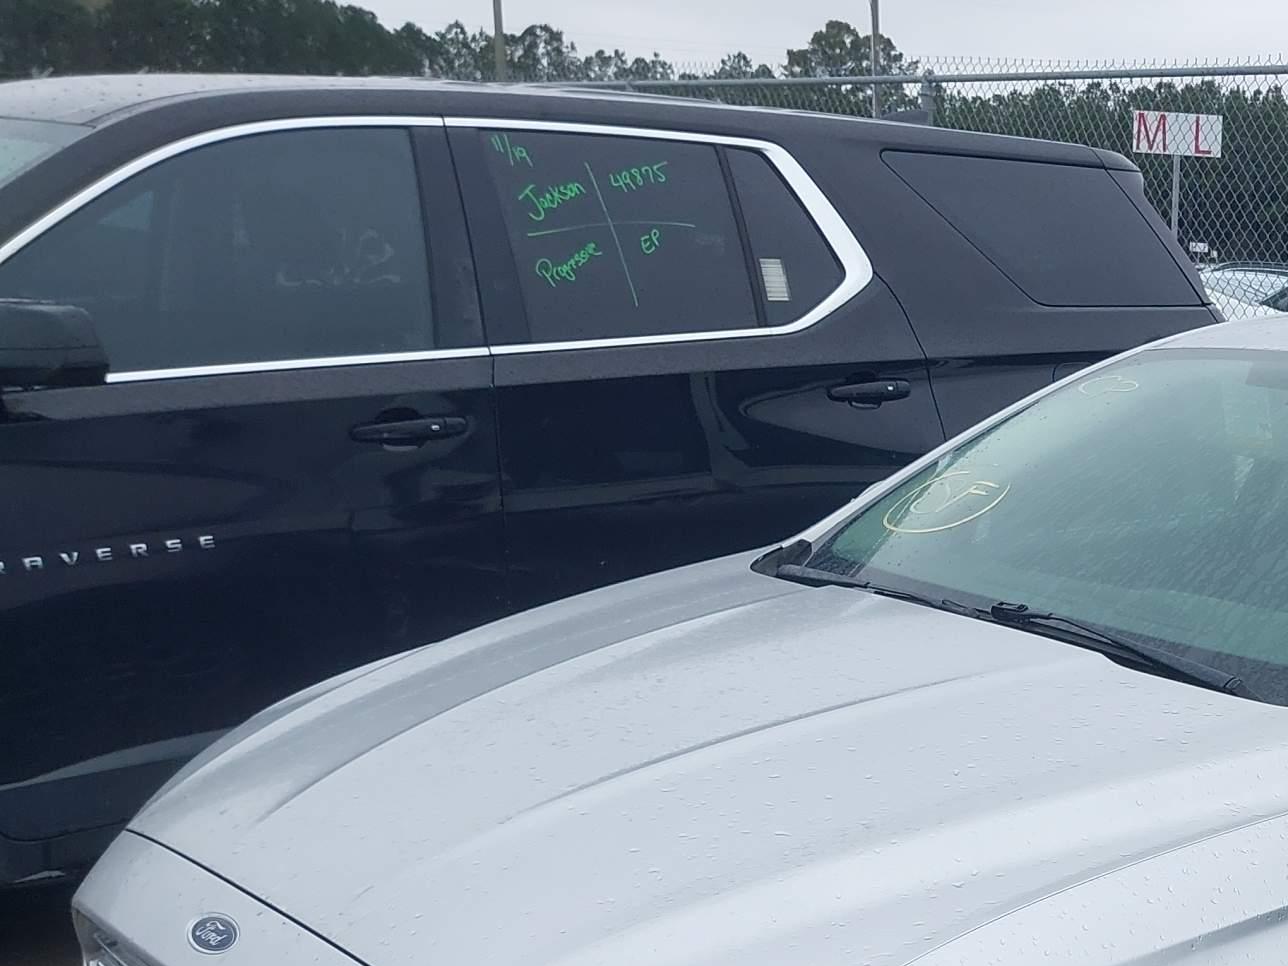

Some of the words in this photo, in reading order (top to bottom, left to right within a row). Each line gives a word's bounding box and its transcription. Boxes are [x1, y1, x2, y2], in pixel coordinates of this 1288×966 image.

[1135, 112, 1167, 153] M
[1194, 115, 1213, 155] L
[609, 160, 668, 193] 49875
[517, 181, 587, 221] Jackson
[640, 228, 660, 254] EP
[195, 920, 229, 946] Ford
